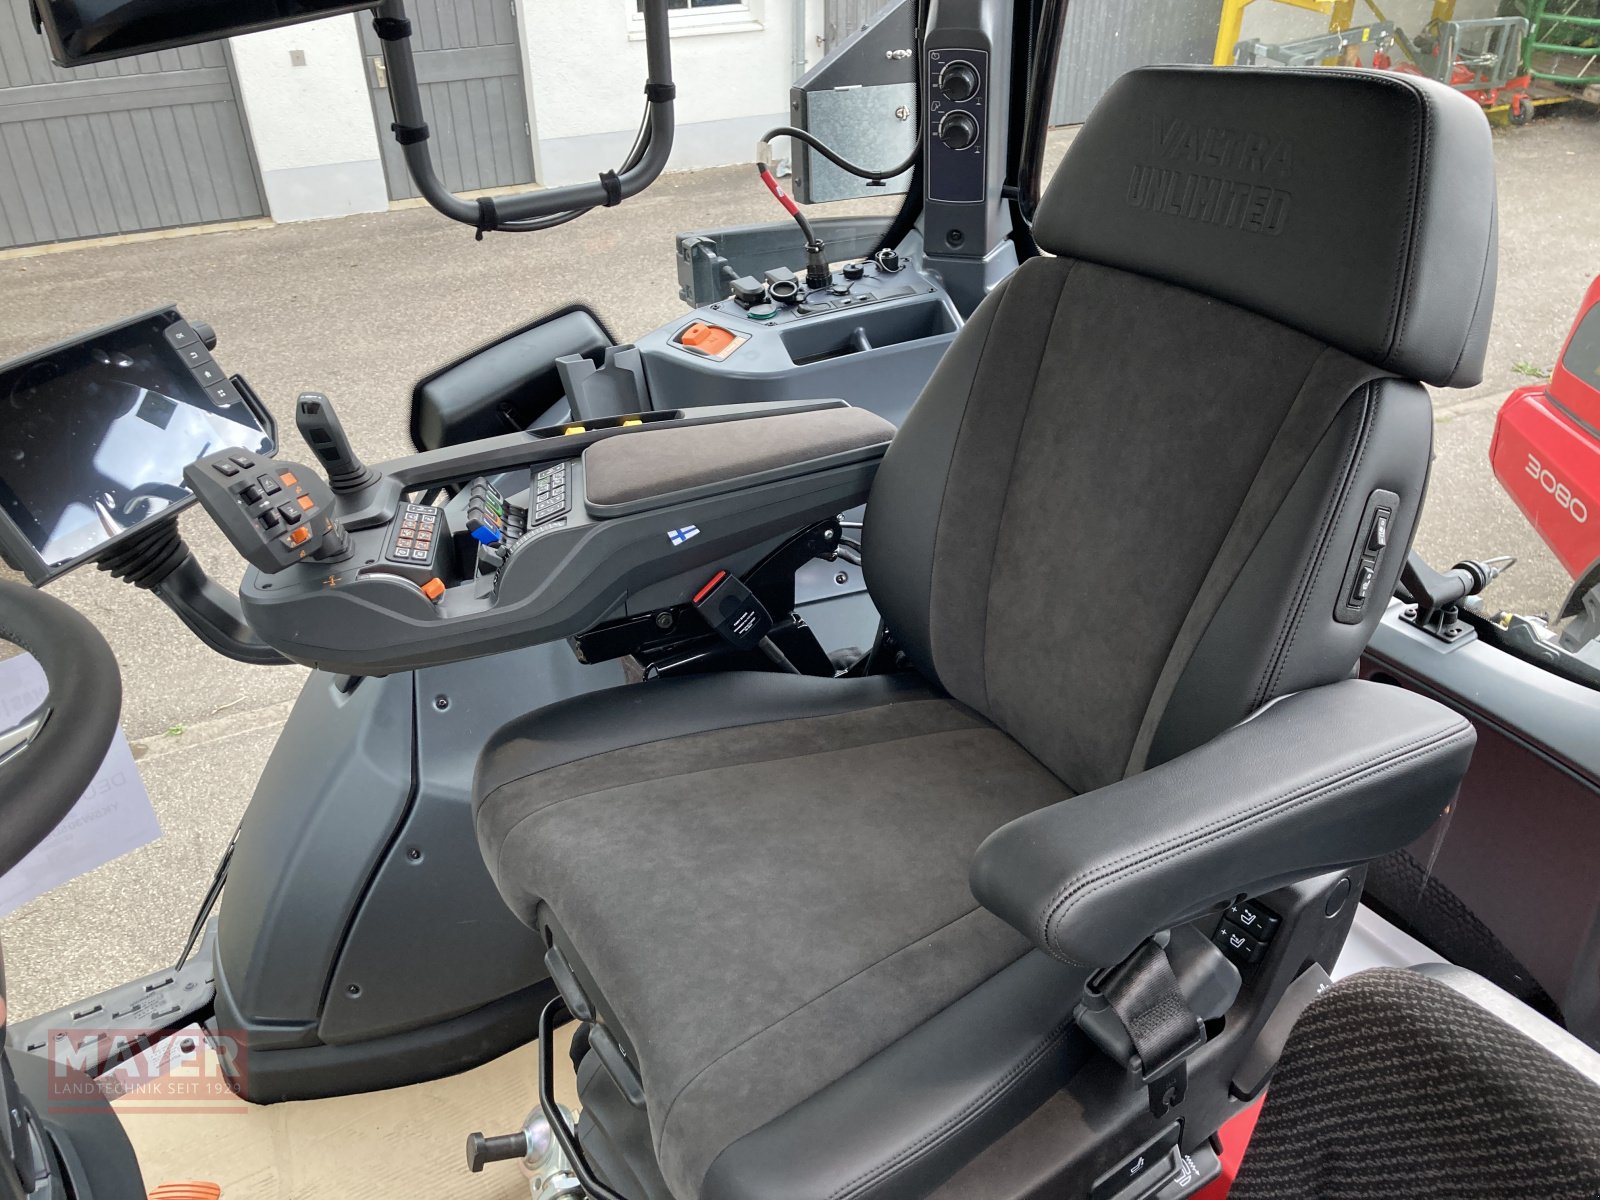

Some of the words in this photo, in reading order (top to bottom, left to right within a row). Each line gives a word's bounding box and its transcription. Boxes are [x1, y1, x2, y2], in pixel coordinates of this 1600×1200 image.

[1151, 113, 1294, 176] VALTRA
[1126, 165, 1293, 237] UNLIMITED
[1524, 453, 1588, 524] 3080
